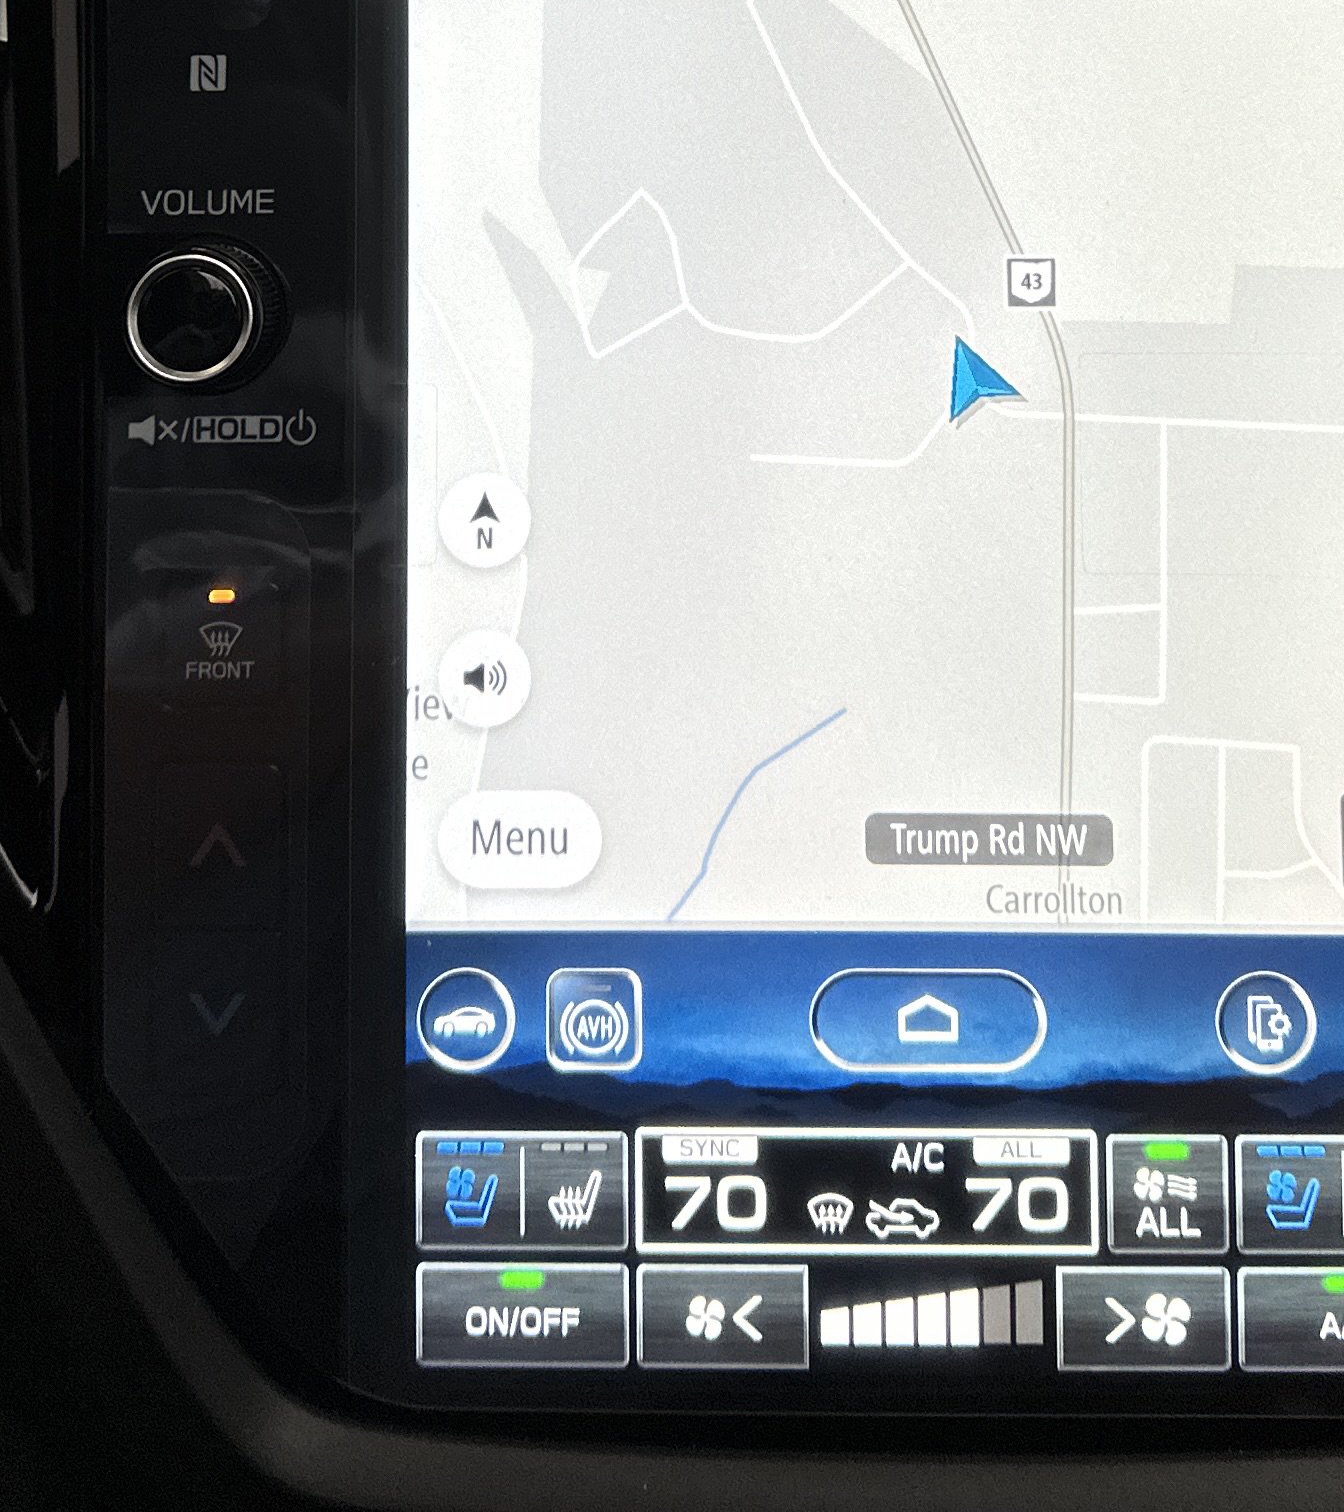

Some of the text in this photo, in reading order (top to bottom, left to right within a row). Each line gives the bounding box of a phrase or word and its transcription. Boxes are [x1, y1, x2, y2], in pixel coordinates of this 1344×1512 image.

[140, 188, 276, 216] VOLUME
[1020, 272, 1043, 290] 43
[476, 527, 493, 550] N
[185, 660, 256, 680] FRONT
[471, 818, 569, 856] Menu
[889, 821, 1089, 863] Trump Rd NW
[985, 881, 1124, 916] Carrollton
[576, 1014, 613, 1041] AVH
[678, 1138, 742, 1158] SYNC
[891, 1142, 945, 1173] A/C
[999, 1139, 1042, 1160] ALL
[663, 1174, 767, 1232] 70
[964, 1176, 1070, 1233] 70
[1135, 1206, 1202, 1239] ALL
[464, 1305, 581, 1338] ON/OFF
